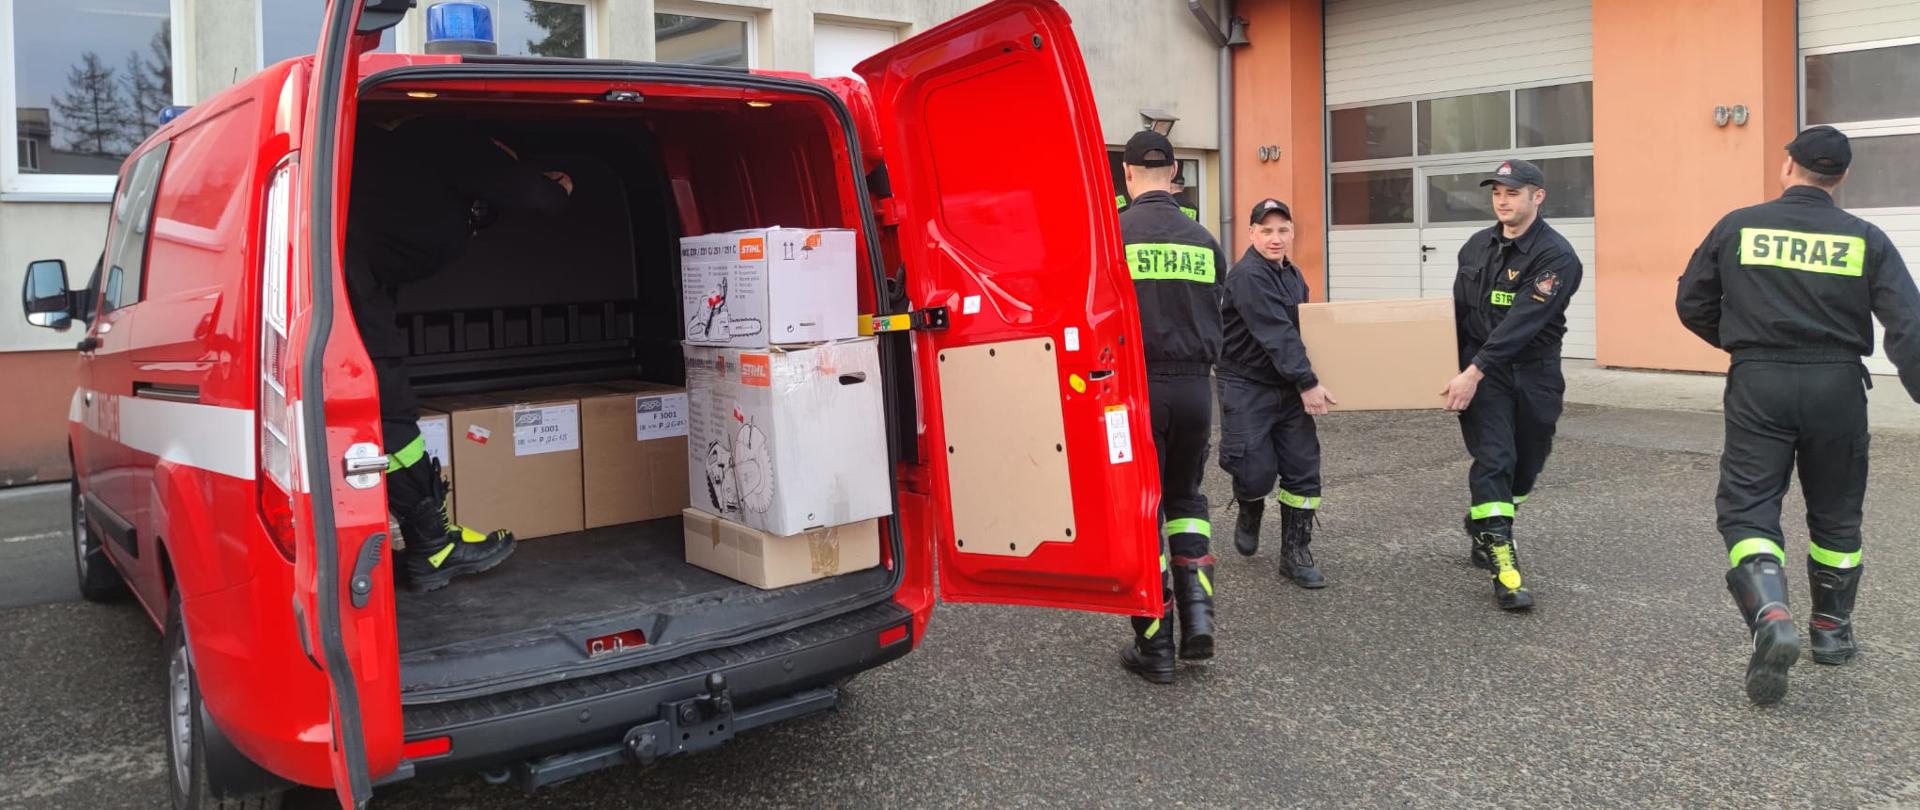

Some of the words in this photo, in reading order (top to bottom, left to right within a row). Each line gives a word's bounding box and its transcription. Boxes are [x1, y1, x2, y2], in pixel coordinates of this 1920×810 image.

[740, 244, 761, 254] STIHL
[741, 363, 766, 377] STIHL
[658, 411, 677, 419] 3001
[539, 424, 559, 434] 3001
